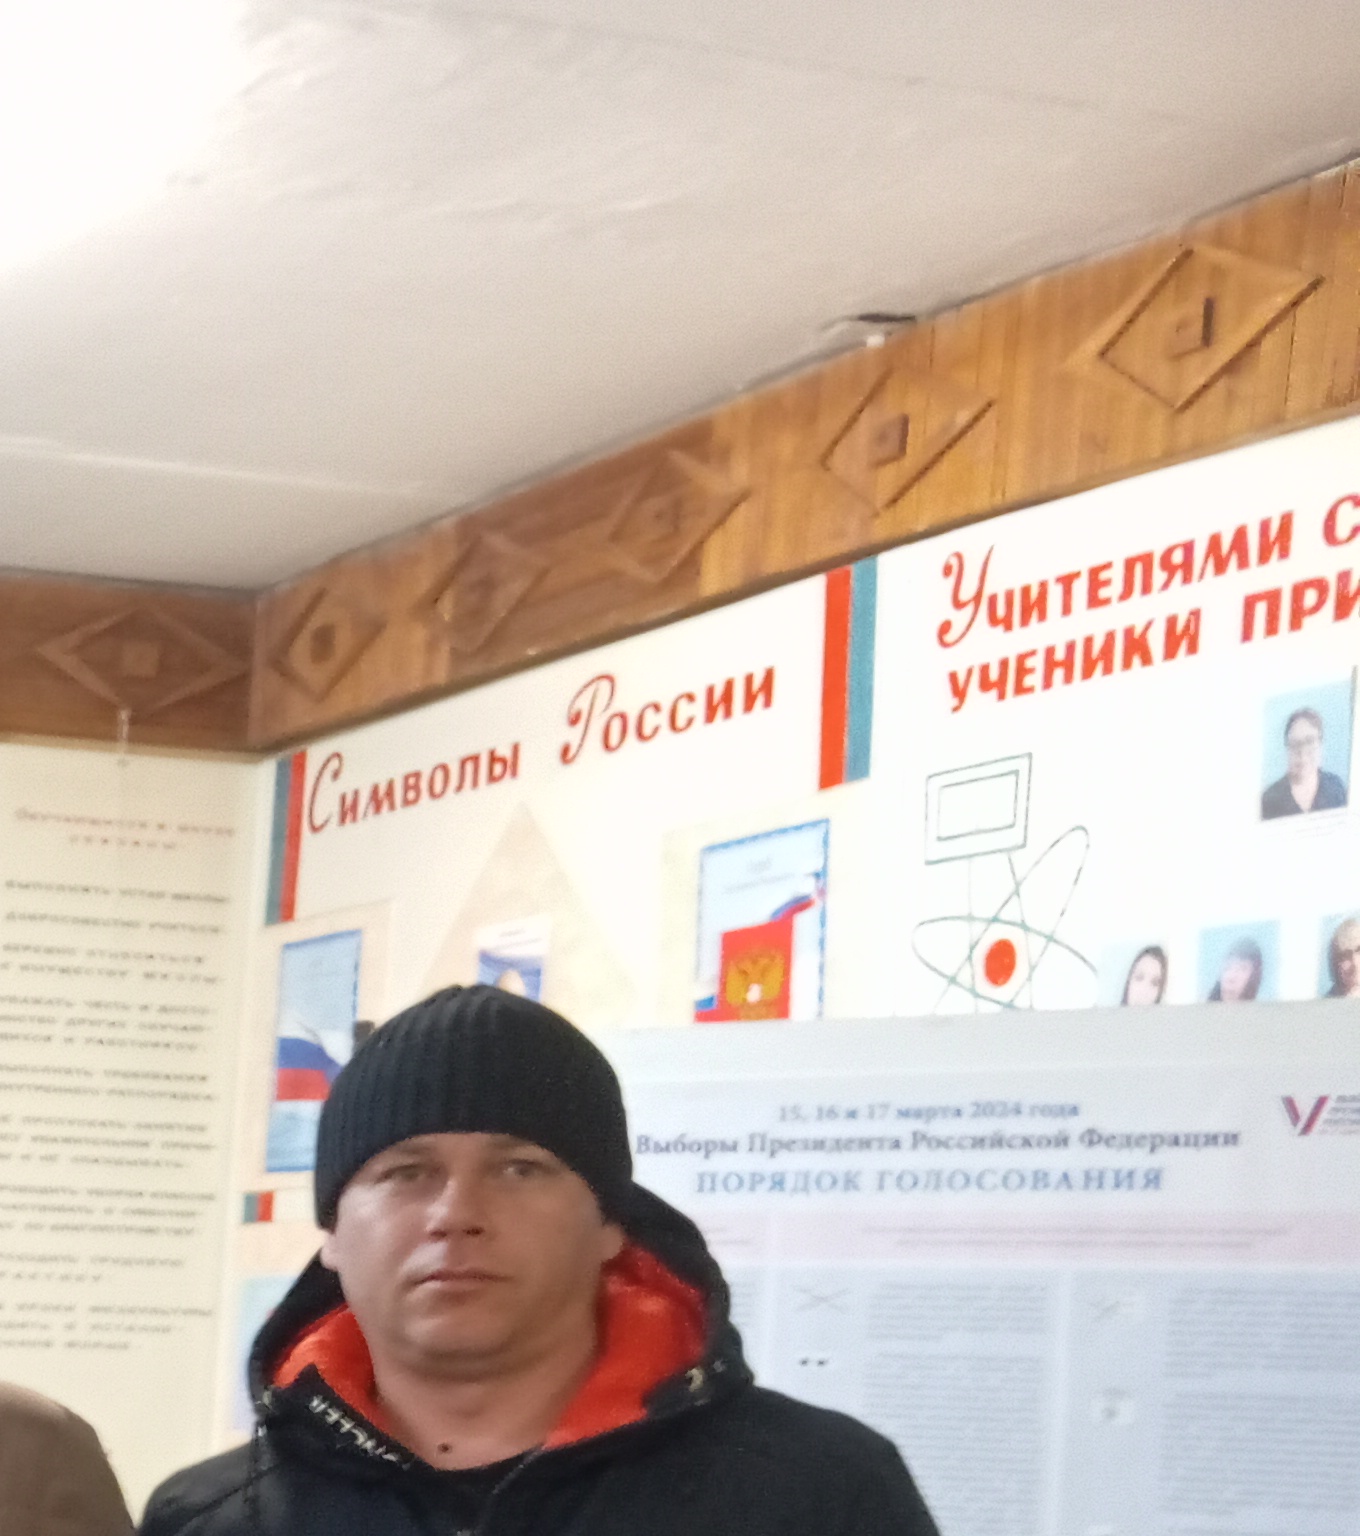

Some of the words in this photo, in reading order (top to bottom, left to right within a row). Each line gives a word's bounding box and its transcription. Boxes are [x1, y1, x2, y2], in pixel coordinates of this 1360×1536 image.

[636, 1132, 739, 1160] Выборы
[747, 1131, 902, 1159] Президента
[912, 1130, 1070, 1151] Российской
[1079, 1127, 1239, 1155] Федерации
[696, 1169, 862, 1196] ПОРЯДОК
[876, 1167, 1163, 1192] ГОЛОСОВАНИЯ
